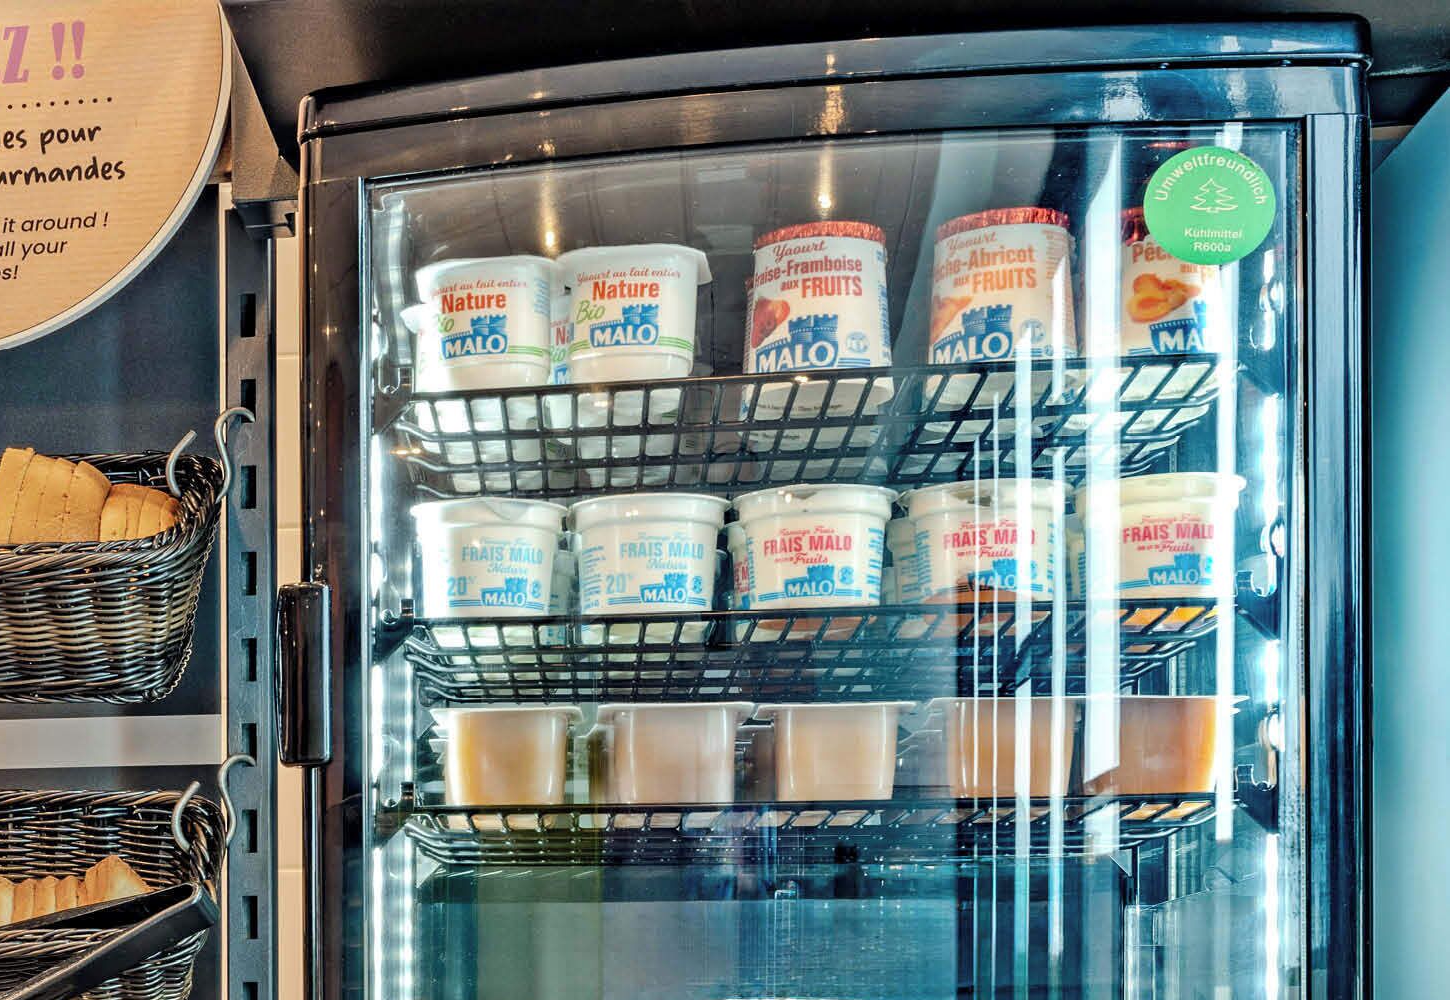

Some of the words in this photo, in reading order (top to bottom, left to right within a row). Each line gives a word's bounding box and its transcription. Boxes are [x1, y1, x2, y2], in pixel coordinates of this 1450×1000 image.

[51, 20, 86, 81] !!
[40, 125, 102, 155] pour
[1153, 152, 1271, 206] Umweltfreundlich
[2, 217, 16, 234] it
[20, 211, 98, 233] around
[102, 211, 110, 228] !
[20, 240, 68, 261] your
[1193, 241, 1232, 253] R600a
[591, 279, 661, 302] Nature
[801, 275, 863, 299] FRUITS
[972, 267, 1037, 294] FRUITS
[441, 292, 508, 315] Nature
[575, 299, 606, 325] Bio
[444, 333, 506, 359] MALO
[593, 323, 657, 347] MALO
[758, 340, 835, 374] MALO
[935, 331, 1010, 365] MALO
[1122, 523, 1171, 545] FRAIS
[461, 545, 505, 562] FRAIS
[508, 547, 544, 565] MALO
[619, 542, 664, 560] FRAIS
[668, 542, 705, 561] MALO
[763, 536, 804, 558] FRAIS
[808, 535, 853, 552] MALO
[787, 579, 834, 596] MALO
[1152, 568, 1200, 585] MALO
[484, 590, 527, 606] MALO
[642, 587, 687, 602] MALO
